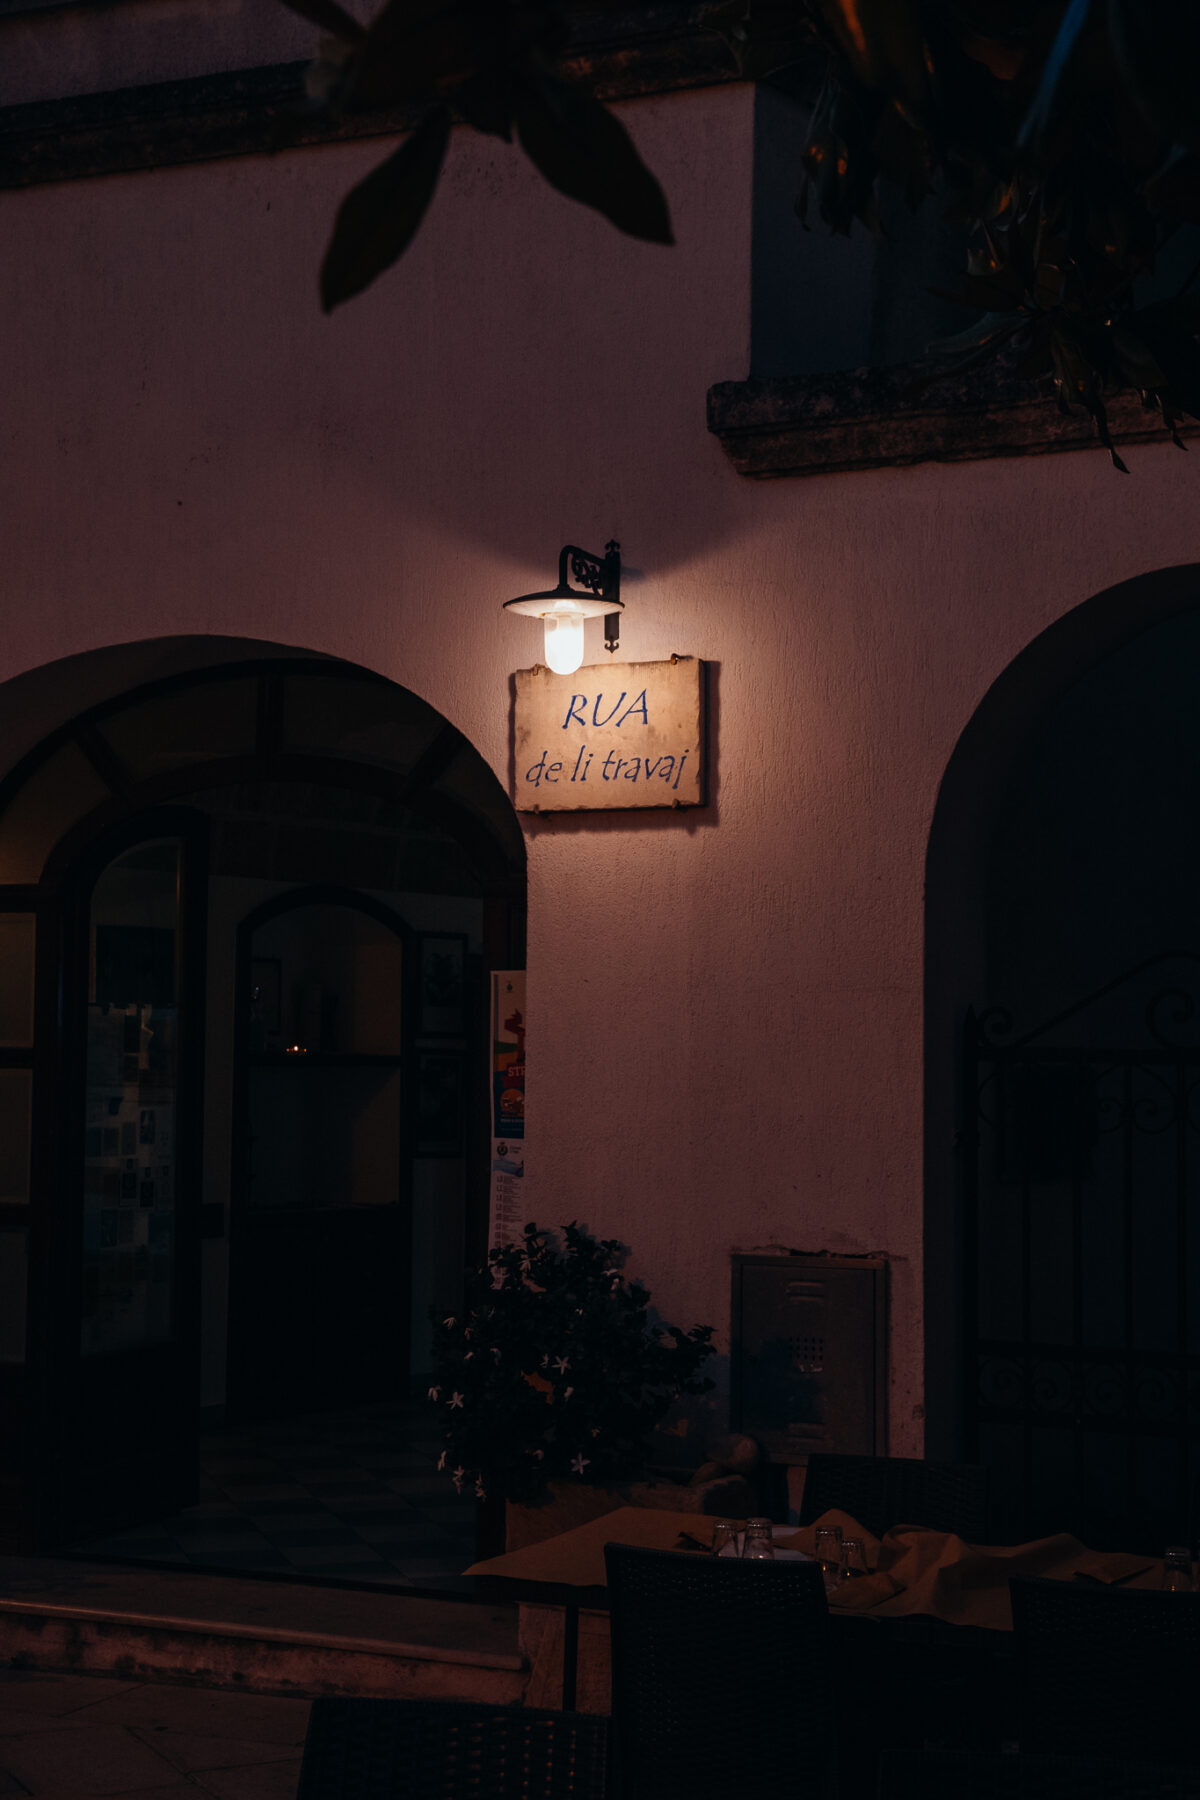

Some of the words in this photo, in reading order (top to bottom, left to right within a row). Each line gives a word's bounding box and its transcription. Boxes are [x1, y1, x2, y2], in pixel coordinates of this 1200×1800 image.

[562, 688, 648, 730] RUA
[525, 750, 563, 788] de
[570, 744, 594, 782] li
[601, 749, 690, 790] travaj
